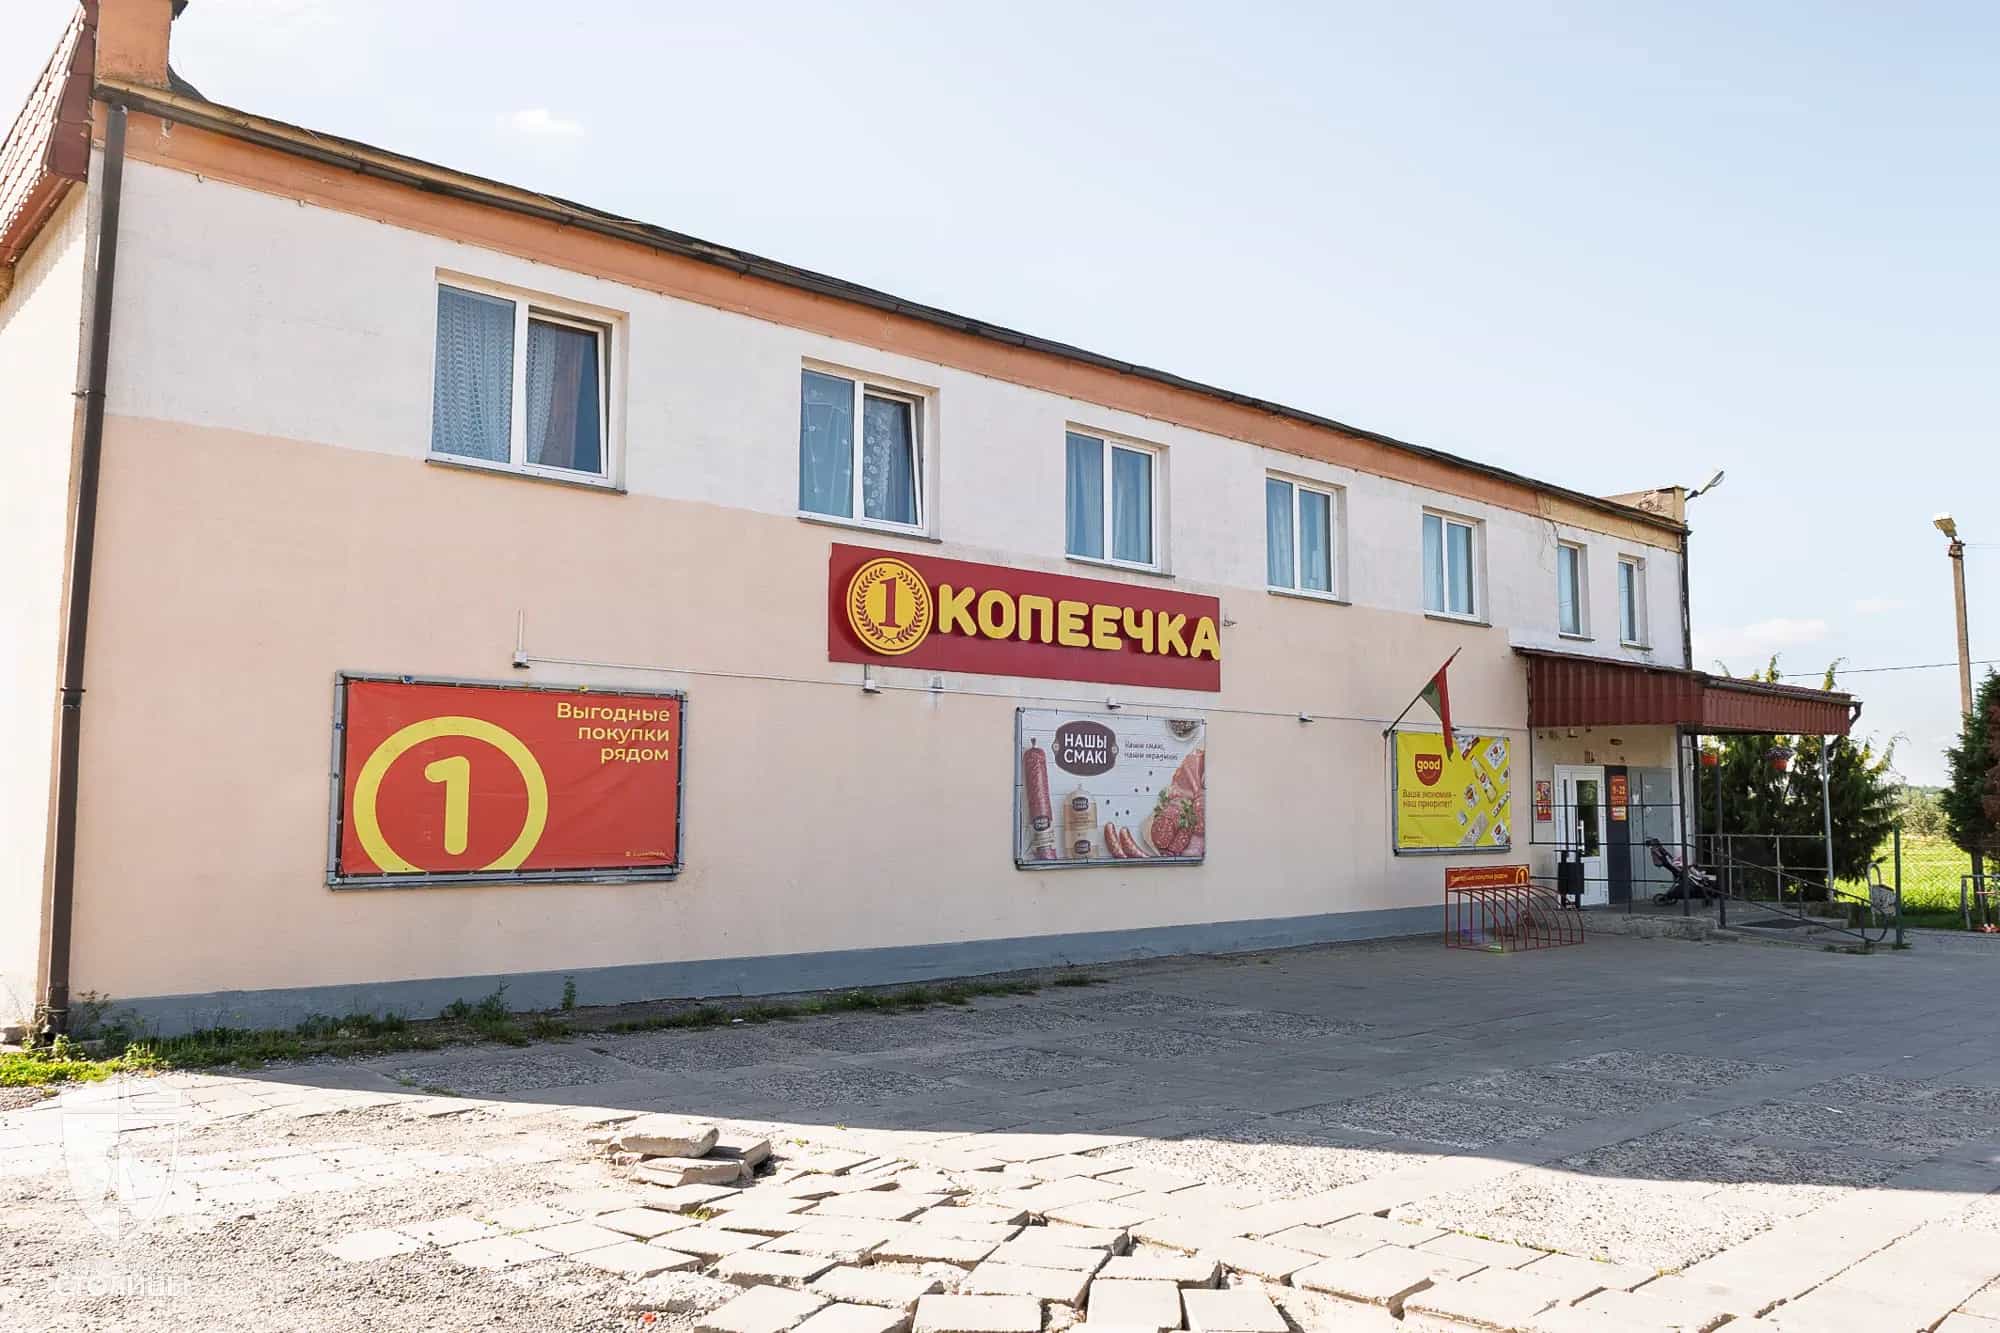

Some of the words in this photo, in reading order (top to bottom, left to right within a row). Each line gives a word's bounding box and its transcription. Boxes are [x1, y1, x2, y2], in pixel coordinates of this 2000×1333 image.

[878, 576, 902, 629] 1
[938, 583, 1221, 661] КОПЕЕЧКА
[556, 702, 671, 723] Выгодные
[578, 724, 670, 744] покупки
[1063, 732, 1108, 749] НАШЫ
[600, 745, 670, 764] рядом
[1063, 748, 1108, 764] СМАКІ
[1416, 758, 1441, 773] good
[424, 755, 471, 856] 1
